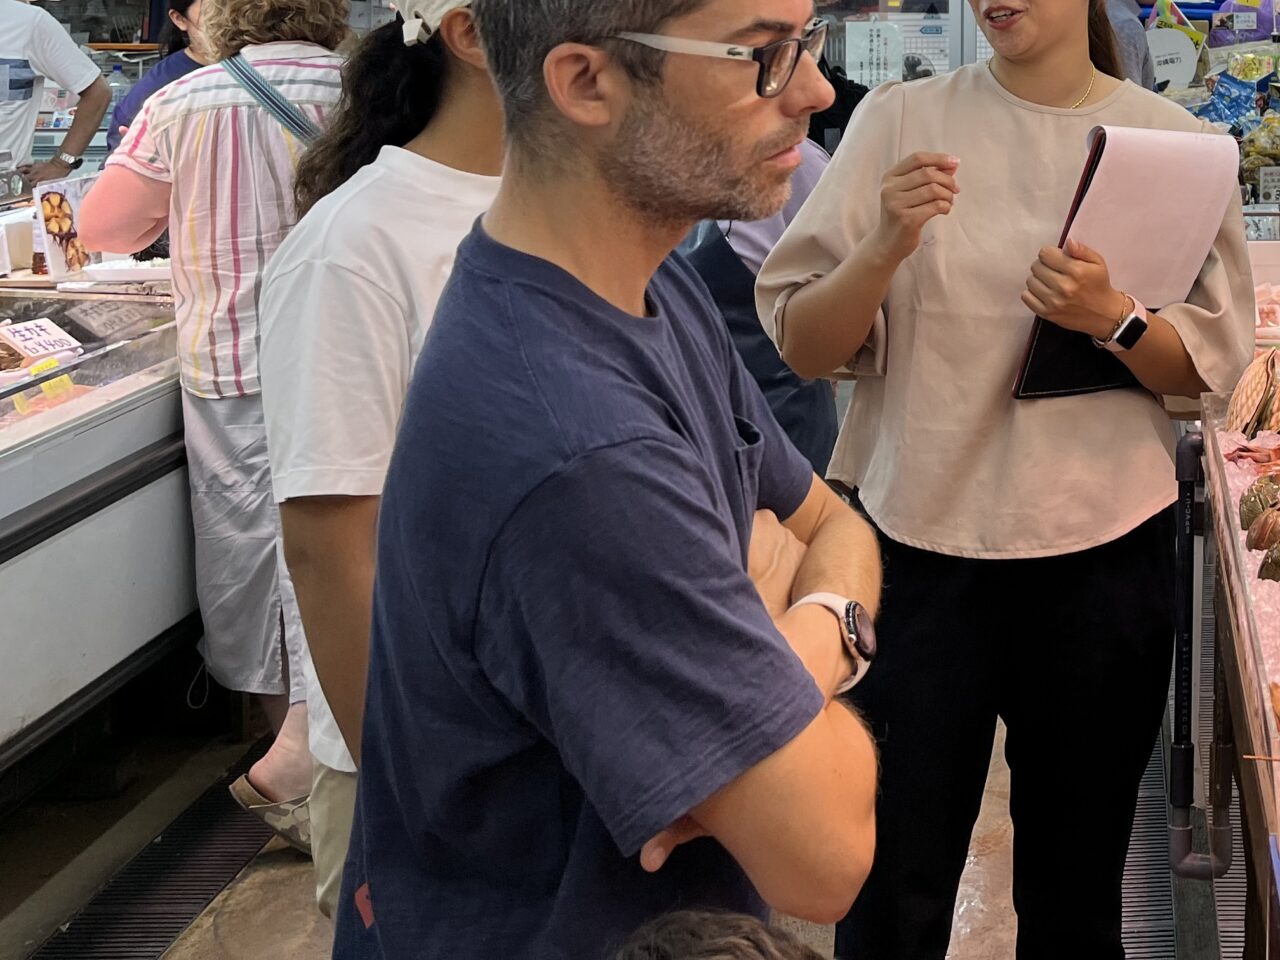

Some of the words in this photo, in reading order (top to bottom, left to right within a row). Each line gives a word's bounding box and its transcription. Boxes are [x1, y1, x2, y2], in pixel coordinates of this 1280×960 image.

[8, 322, 51, 343] 生カキ
[37, 338, 73, 352] ¥400
